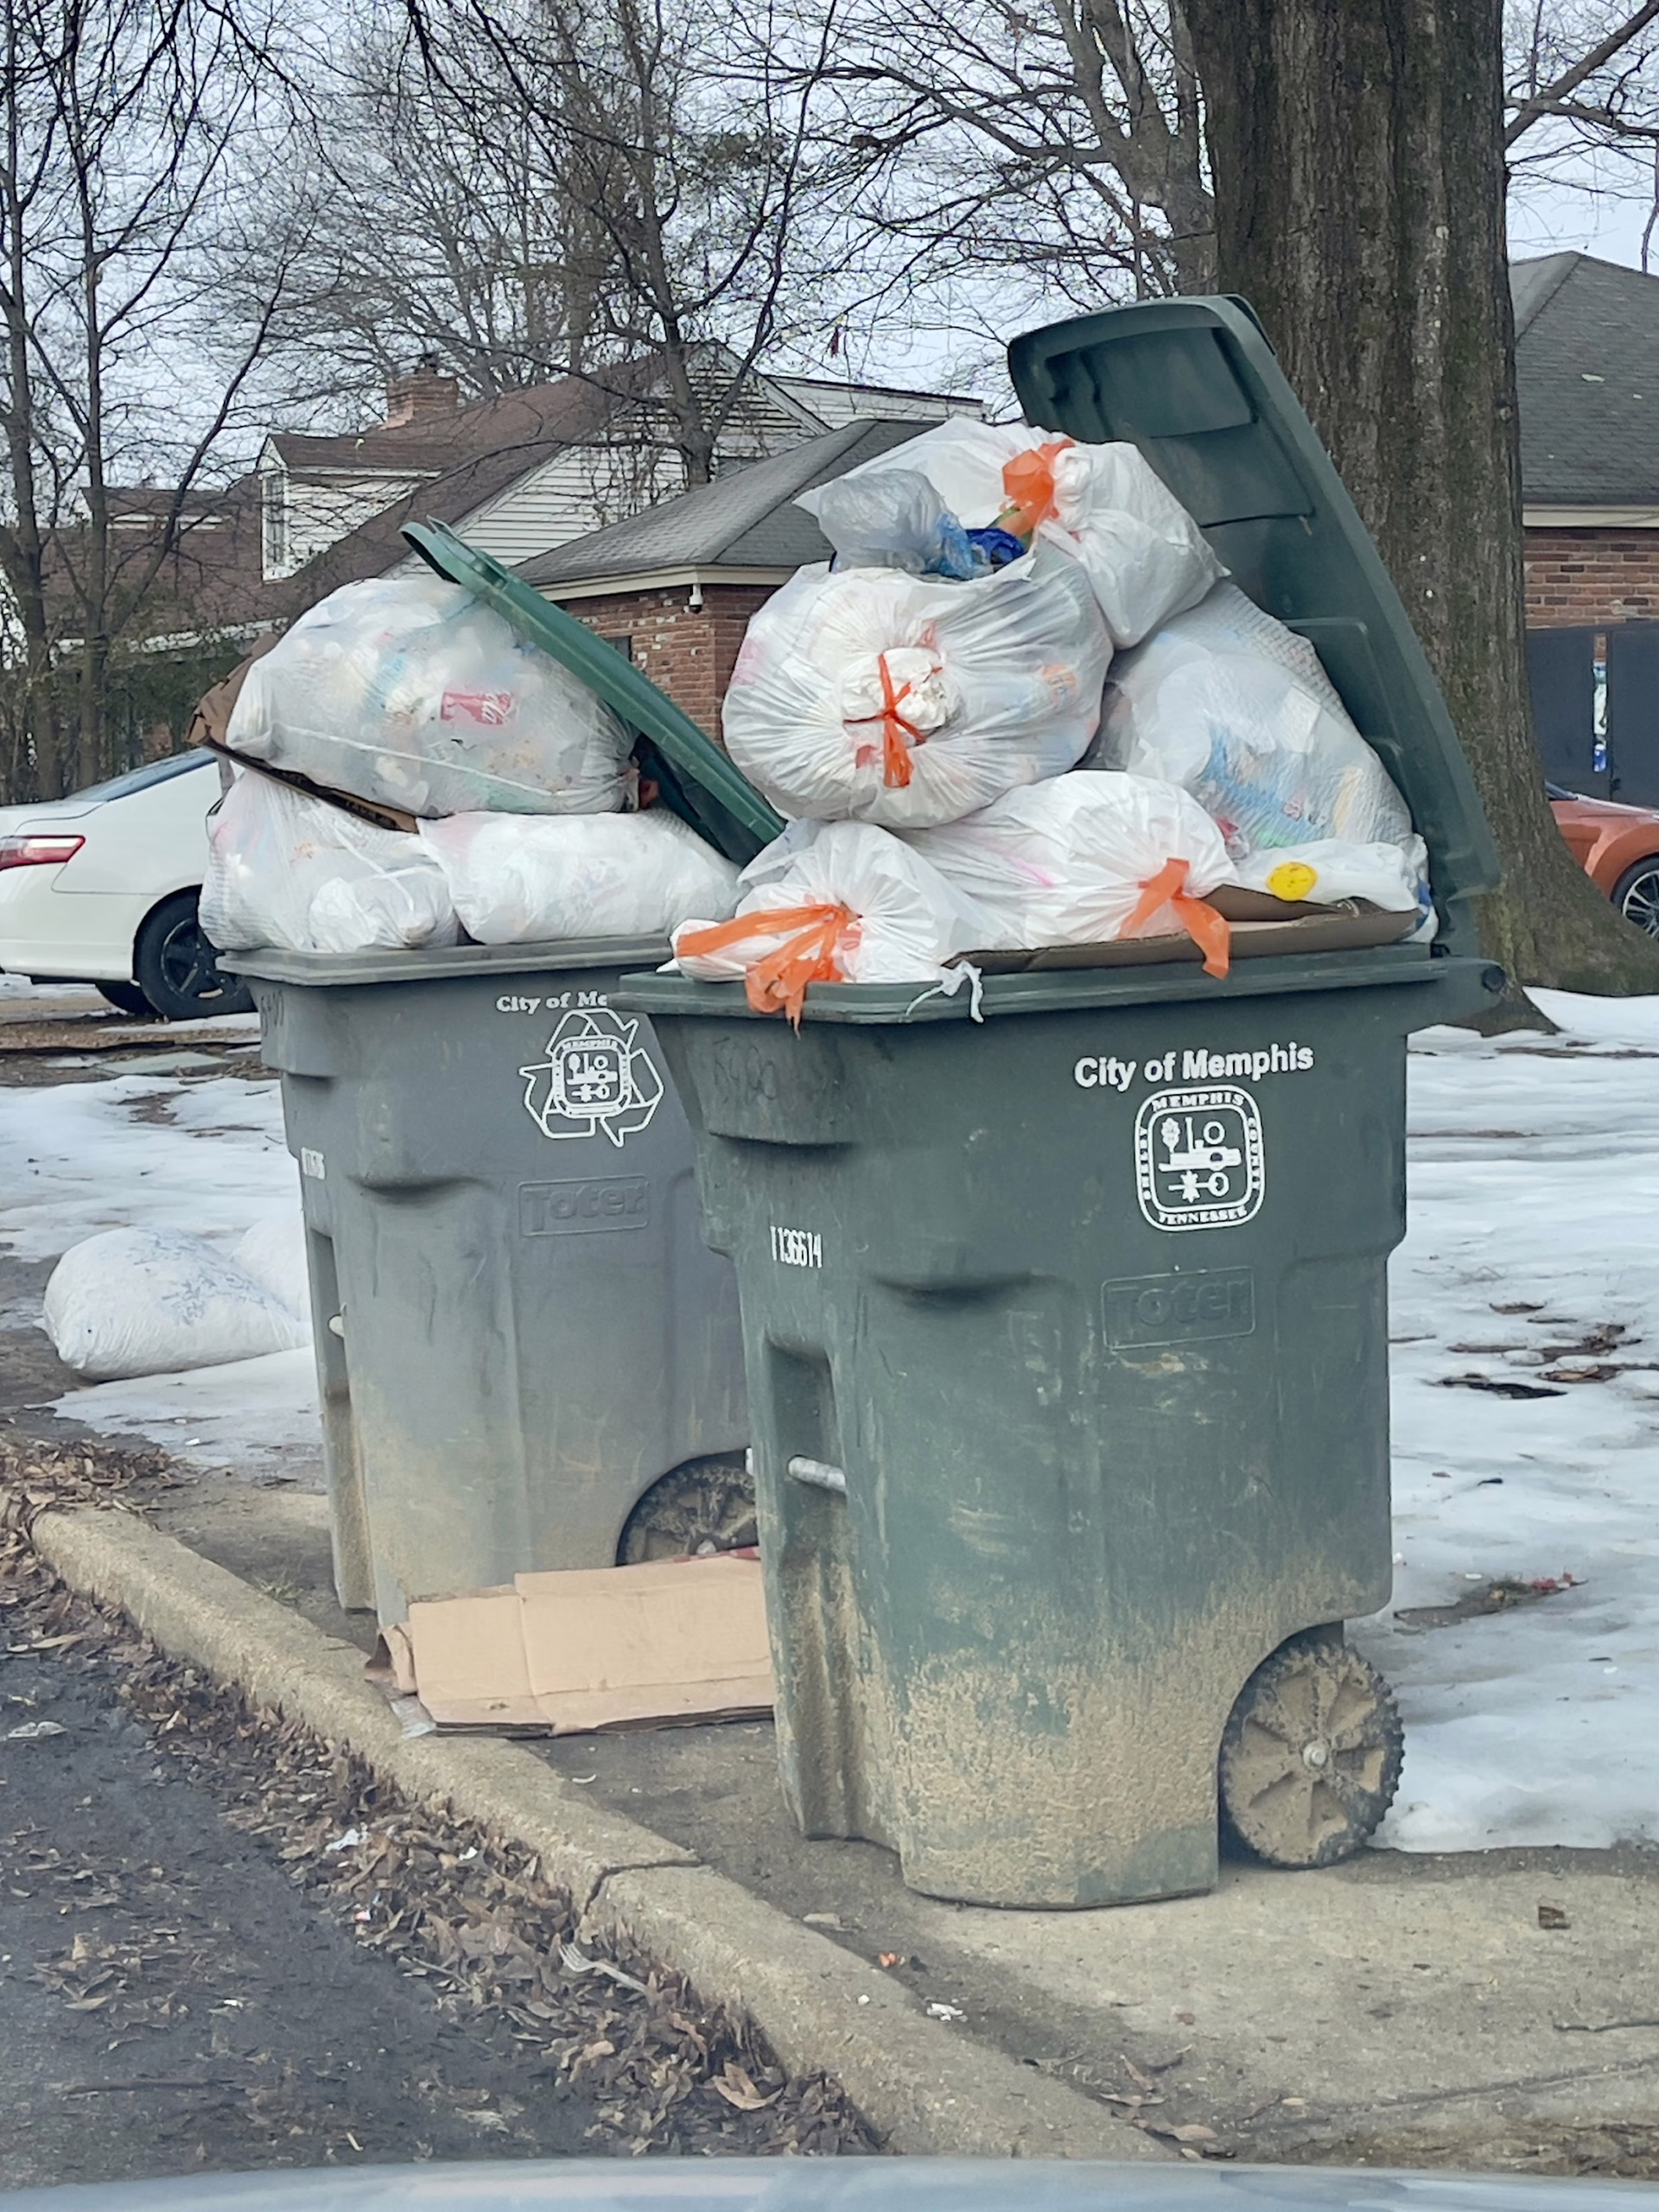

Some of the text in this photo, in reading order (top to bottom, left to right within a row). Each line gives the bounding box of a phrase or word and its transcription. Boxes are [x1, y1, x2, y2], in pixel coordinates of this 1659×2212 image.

[497, 990, 607, 1014] City of Me
[1074, 1042, 1313, 1091] City of Memphis
[1152, 1092, 1244, 1112] MEMPHIS
[1159, 1206, 1247, 1225] TENNESSEE
